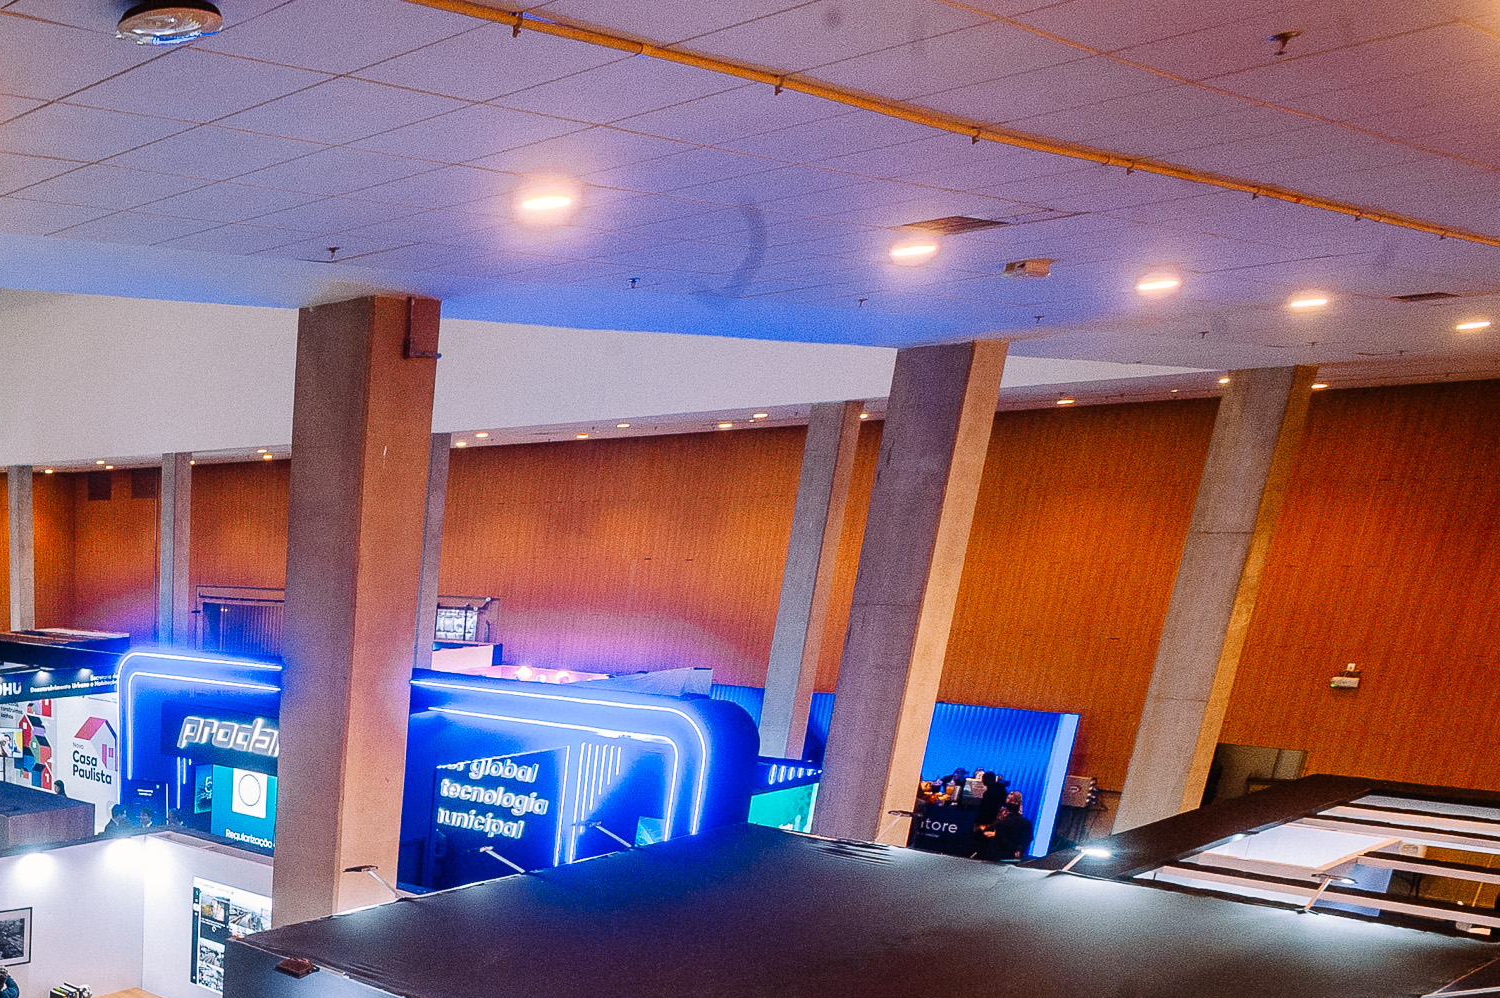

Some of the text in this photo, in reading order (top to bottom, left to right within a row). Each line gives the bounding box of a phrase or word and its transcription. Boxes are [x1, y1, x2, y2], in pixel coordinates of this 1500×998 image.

[177, 716, 279, 758] proda
[72, 750, 98, 767] Casa
[468, 758, 539, 783] global
[72, 764, 112, 785] Paulista
[440, 778, 549, 816] tecnologia
